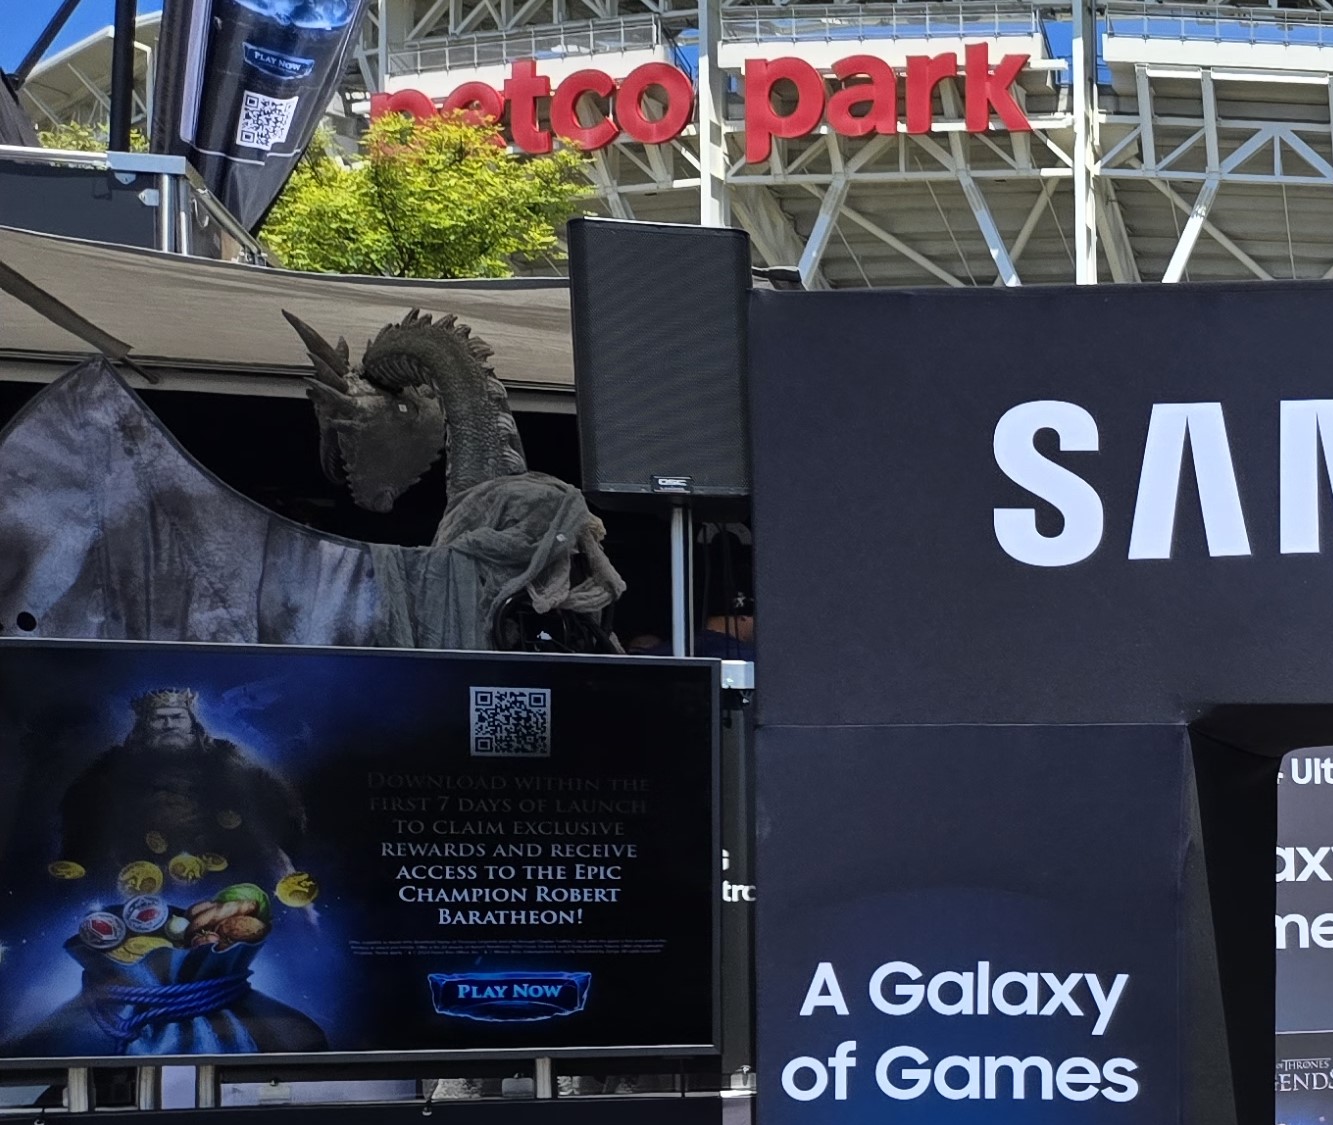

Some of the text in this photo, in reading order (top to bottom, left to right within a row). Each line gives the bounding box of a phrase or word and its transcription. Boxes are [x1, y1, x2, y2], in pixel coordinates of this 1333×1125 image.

[254, 51, 302, 71] PLAY NOW
[744, 42, 1033, 163] park
[367, 771, 650, 792] DOWNLOAD WITHIN THE
[369, 795, 648, 815] FIRST 7 DAYS OF LAUNCH
[392, 819, 625, 836] TO CLAIM EXCLUSIVE
[381, 842, 638, 858] REWARDS AND RECEIVE
[395, 863, 622, 880] ACCESS TO THE EPIC
[398, 885, 622, 903] CHAMPION ROBERT
[438, 907, 584, 925] BARATHEON!
[457, 983, 563, 999] PLAY NOW
[799, 960, 1130, 1036] A Galaxy
[781, 1040, 1140, 1103] of Games
[1281, 1057, 1332, 1072] THRONES
